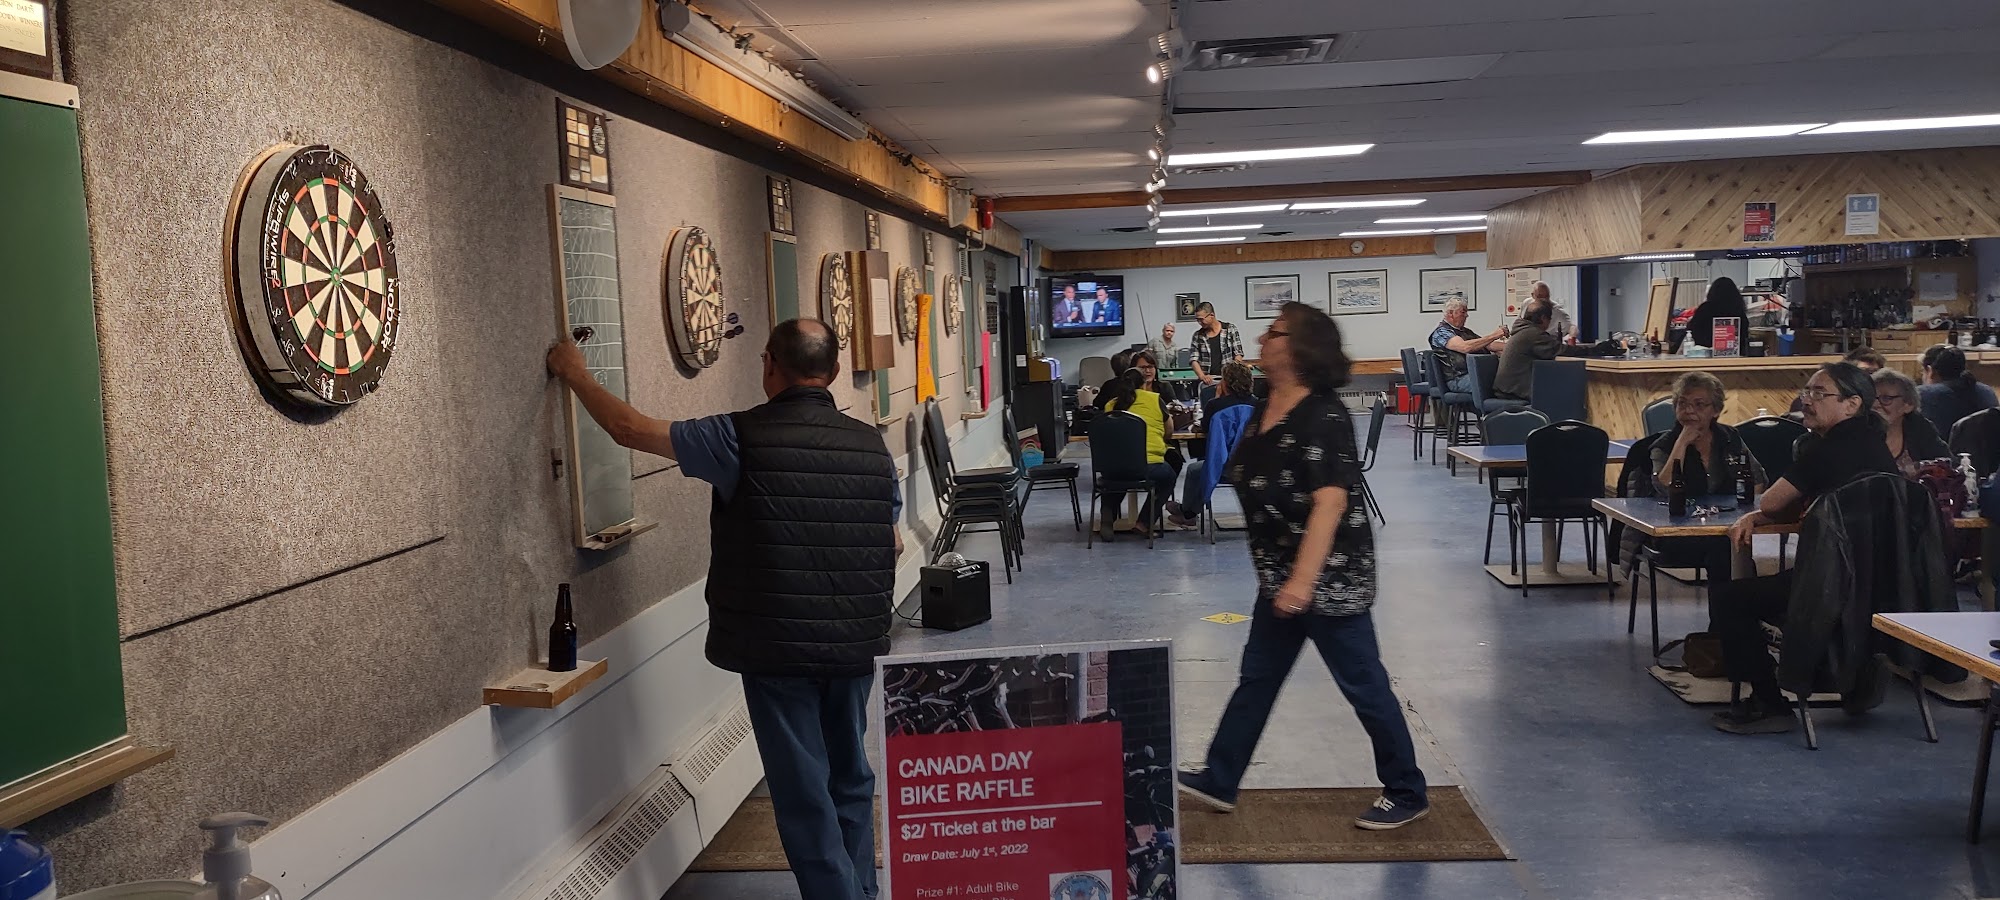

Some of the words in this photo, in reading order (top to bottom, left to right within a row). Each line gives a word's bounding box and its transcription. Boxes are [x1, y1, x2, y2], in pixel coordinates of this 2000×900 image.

[380, 278, 395, 349] NODOR
[898, 753, 987, 778] CANADA
[990, 750, 1033, 772] DAY
[900, 784, 951, 806] BIKE
[956, 777, 1035, 801] RAFFLE
[901, 823, 927, 841] $2/
[930, 821, 978, 838] Ticket
[982, 819, 998, 834] at
[1001, 816, 1026, 832] the
[1030, 815, 1056, 830] bar
[902, 852, 929, 863] Draw
[931, 849, 958, 861] Date:
[960, 848, 980, 859] July
[1000, 843, 1029, 855] 2022
[916, 888, 944, 898] Prize
[946, 885, 963, 896] #1:
[966, 883, 993, 895] Adult
[995, 881, 1019, 892] Bike
